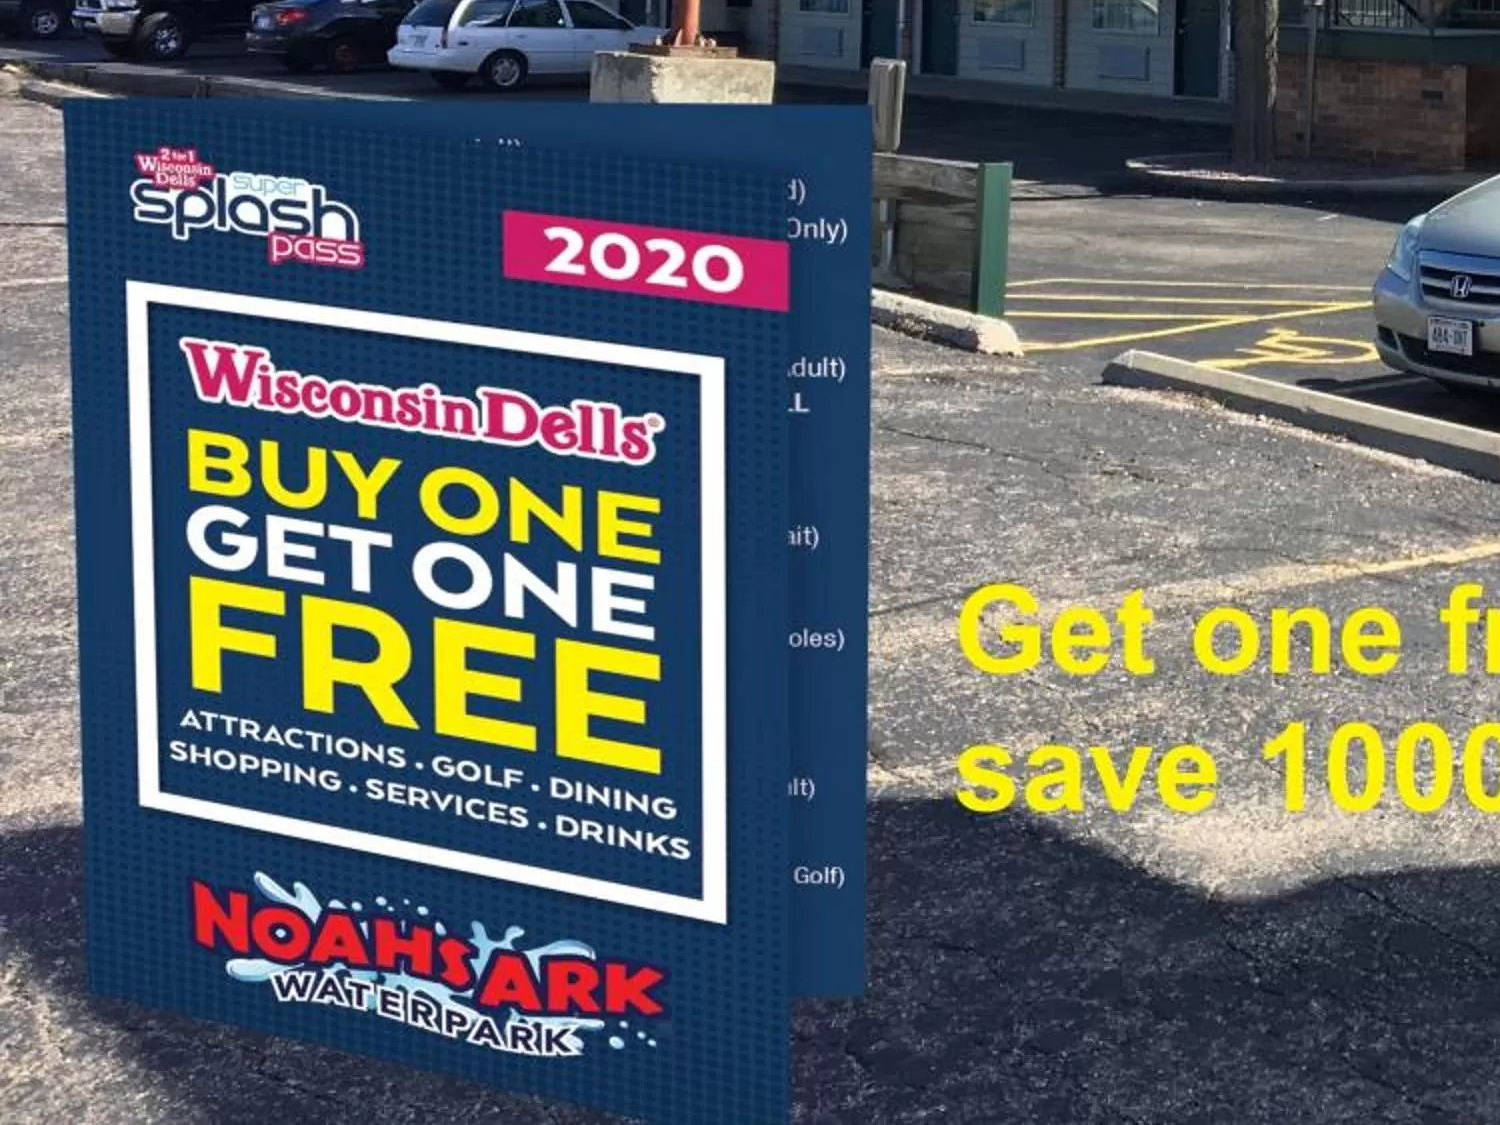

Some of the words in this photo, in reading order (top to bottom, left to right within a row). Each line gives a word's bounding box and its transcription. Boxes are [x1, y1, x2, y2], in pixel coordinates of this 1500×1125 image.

[138, 154, 212, 176] Wisconsin
[155, 172, 197, 187] Dells
[160, 148, 171, 162] 2
[232, 175, 304, 197] super
[131, 174, 358, 240] splash
[787, 217, 849, 245] Only)
[271, 235, 361, 265] pass
[544, 225, 745, 294] 2020
[183, 339, 476, 437] Wisconsin
[788, 356, 846, 383] dult)
[188, 428, 402, 520] BUY
[419, 466, 662, 564] ONE
[185, 503, 393, 594] GET
[411, 540, 656, 642] ONE
[189, 576, 662, 775] FREE
[179, 709, 408, 769] ATTRACTIONS
[431, 755, 524, 789] GOLF
[549, 777, 679, 821] DINING
[168, 740, 343, 792] SHOPPING
[365, 778, 530, 828] SERVICES
[555, 815, 692, 861] DRINKS
[793, 866, 846, 889] Golf)
[271, 970, 587, 1057] WATERPARK
[478, 953, 665, 1017] ARK
